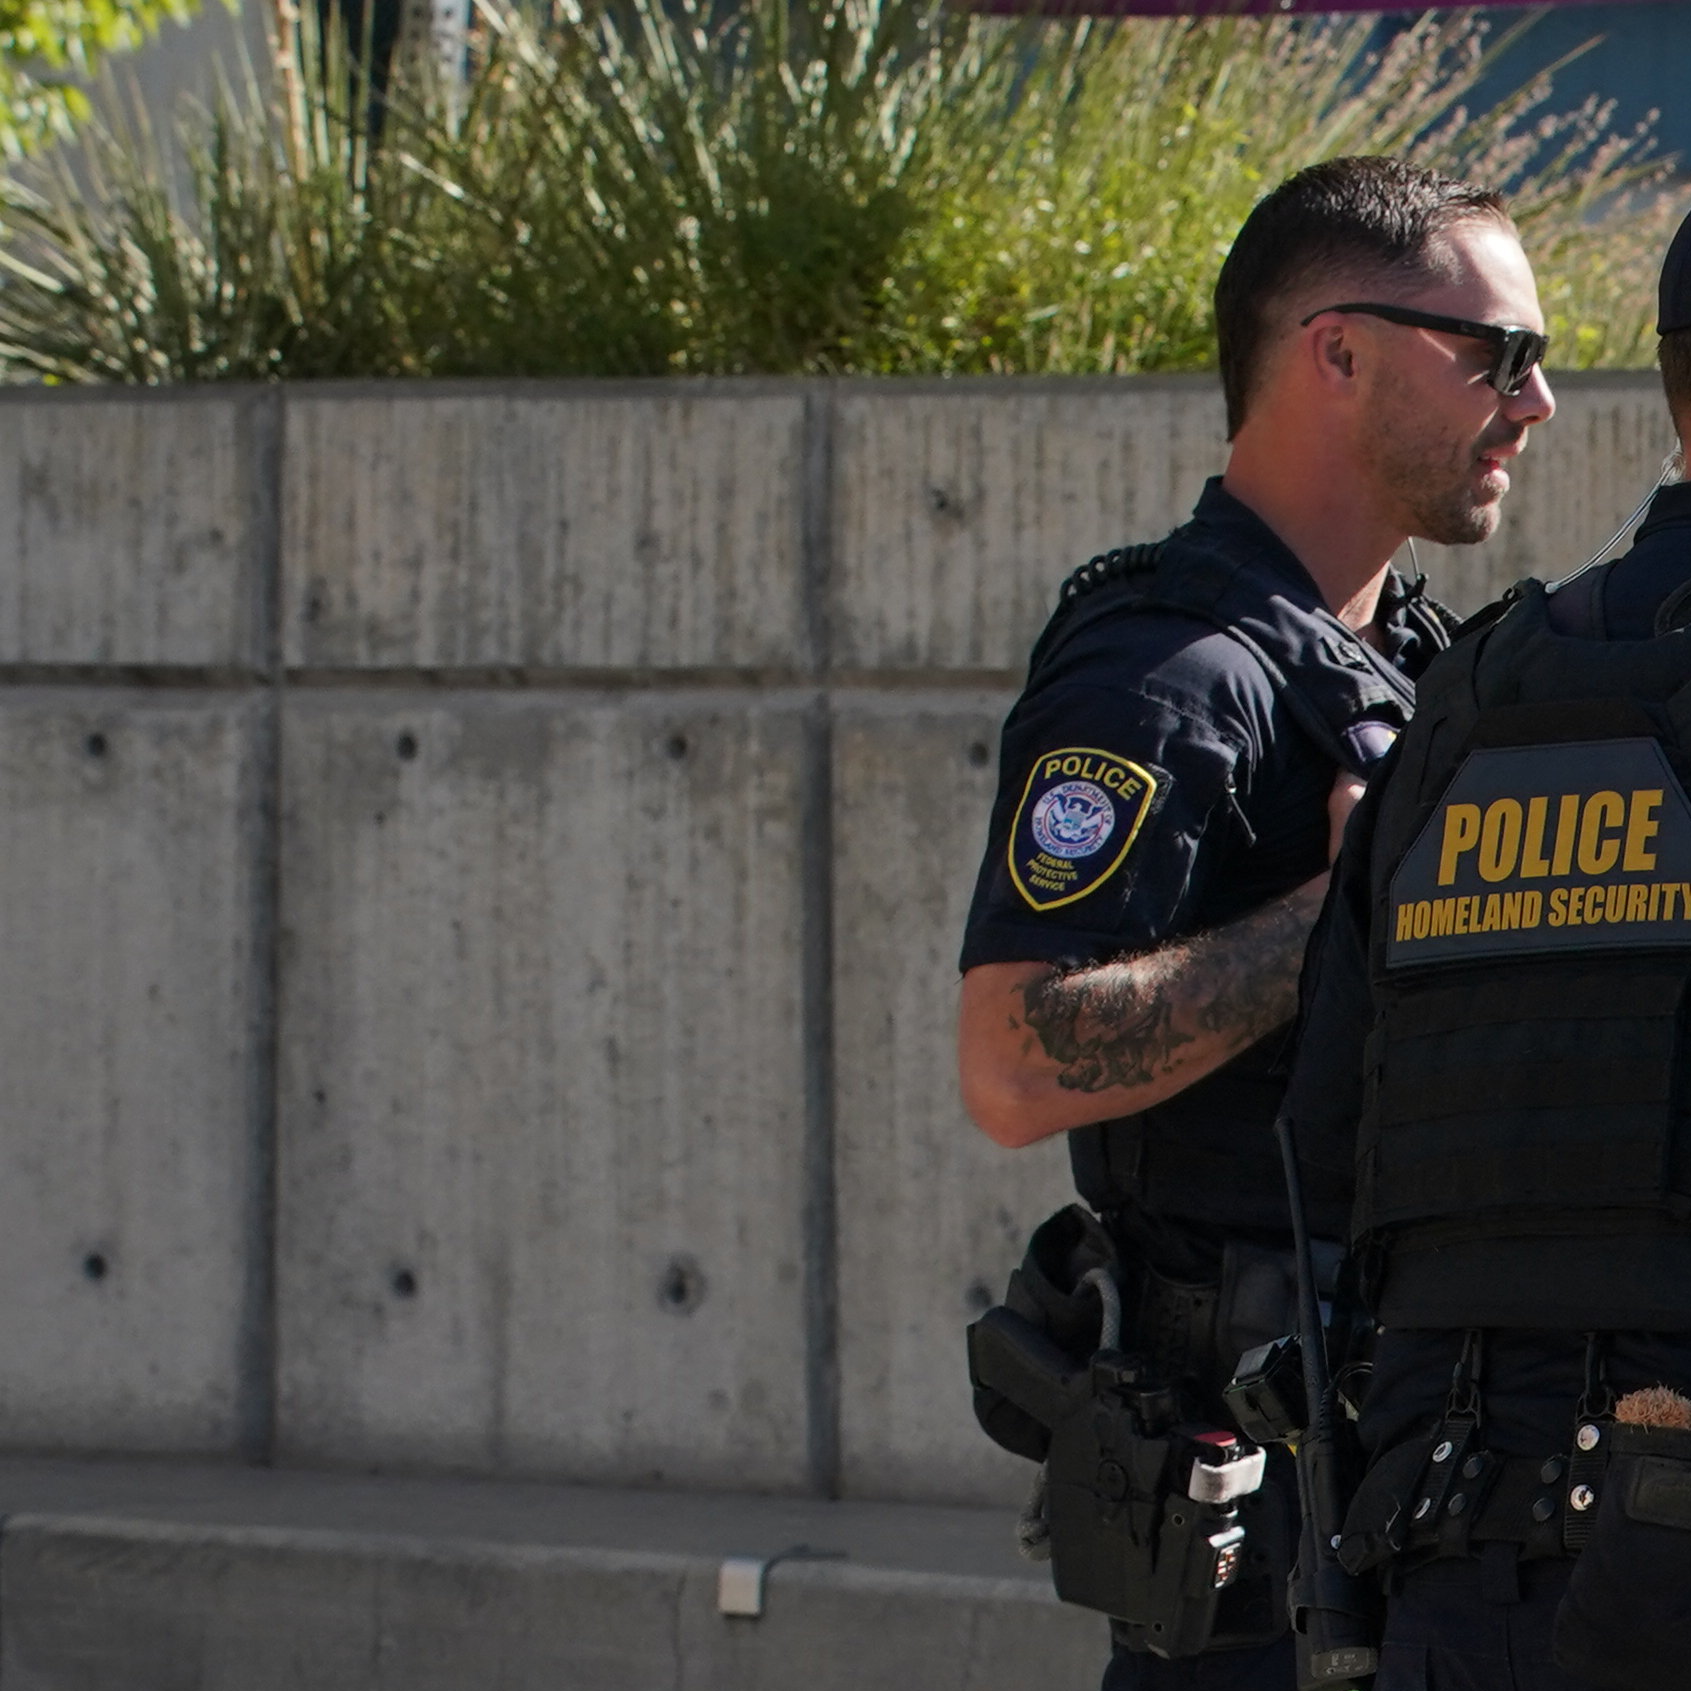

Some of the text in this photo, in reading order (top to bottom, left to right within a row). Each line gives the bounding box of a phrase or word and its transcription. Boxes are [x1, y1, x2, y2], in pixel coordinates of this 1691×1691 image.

[1044, 756, 1142, 800] POLICE
[1437, 789, 1664, 886] POLICE
[1396, 890, 1543, 942] HOMELAND
